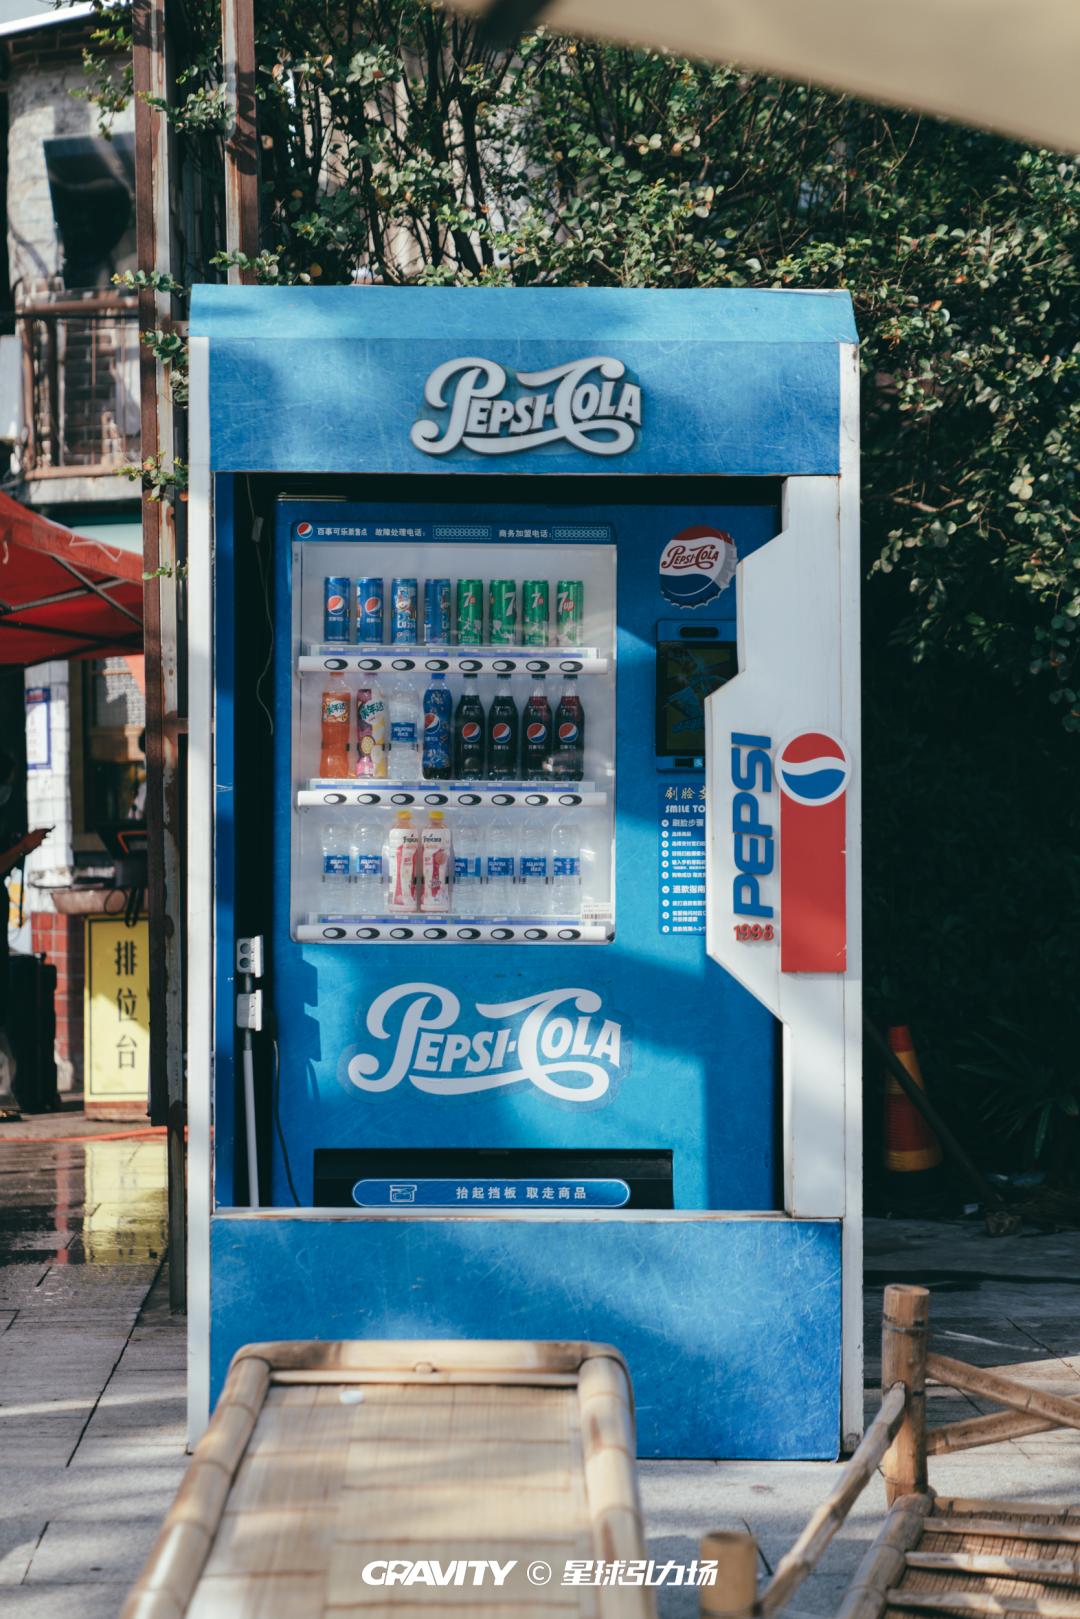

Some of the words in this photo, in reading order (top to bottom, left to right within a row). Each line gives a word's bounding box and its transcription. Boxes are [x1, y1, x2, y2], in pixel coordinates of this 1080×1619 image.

[665, 804, 690, 813] SMILE
[730, 731, 774, 918] PEPSI
[114, 940, 138, 1069] 排位台
[456, 1186, 517, 1201] 抬起挡板
[526, 1186, 587, 1201] 取走商品
